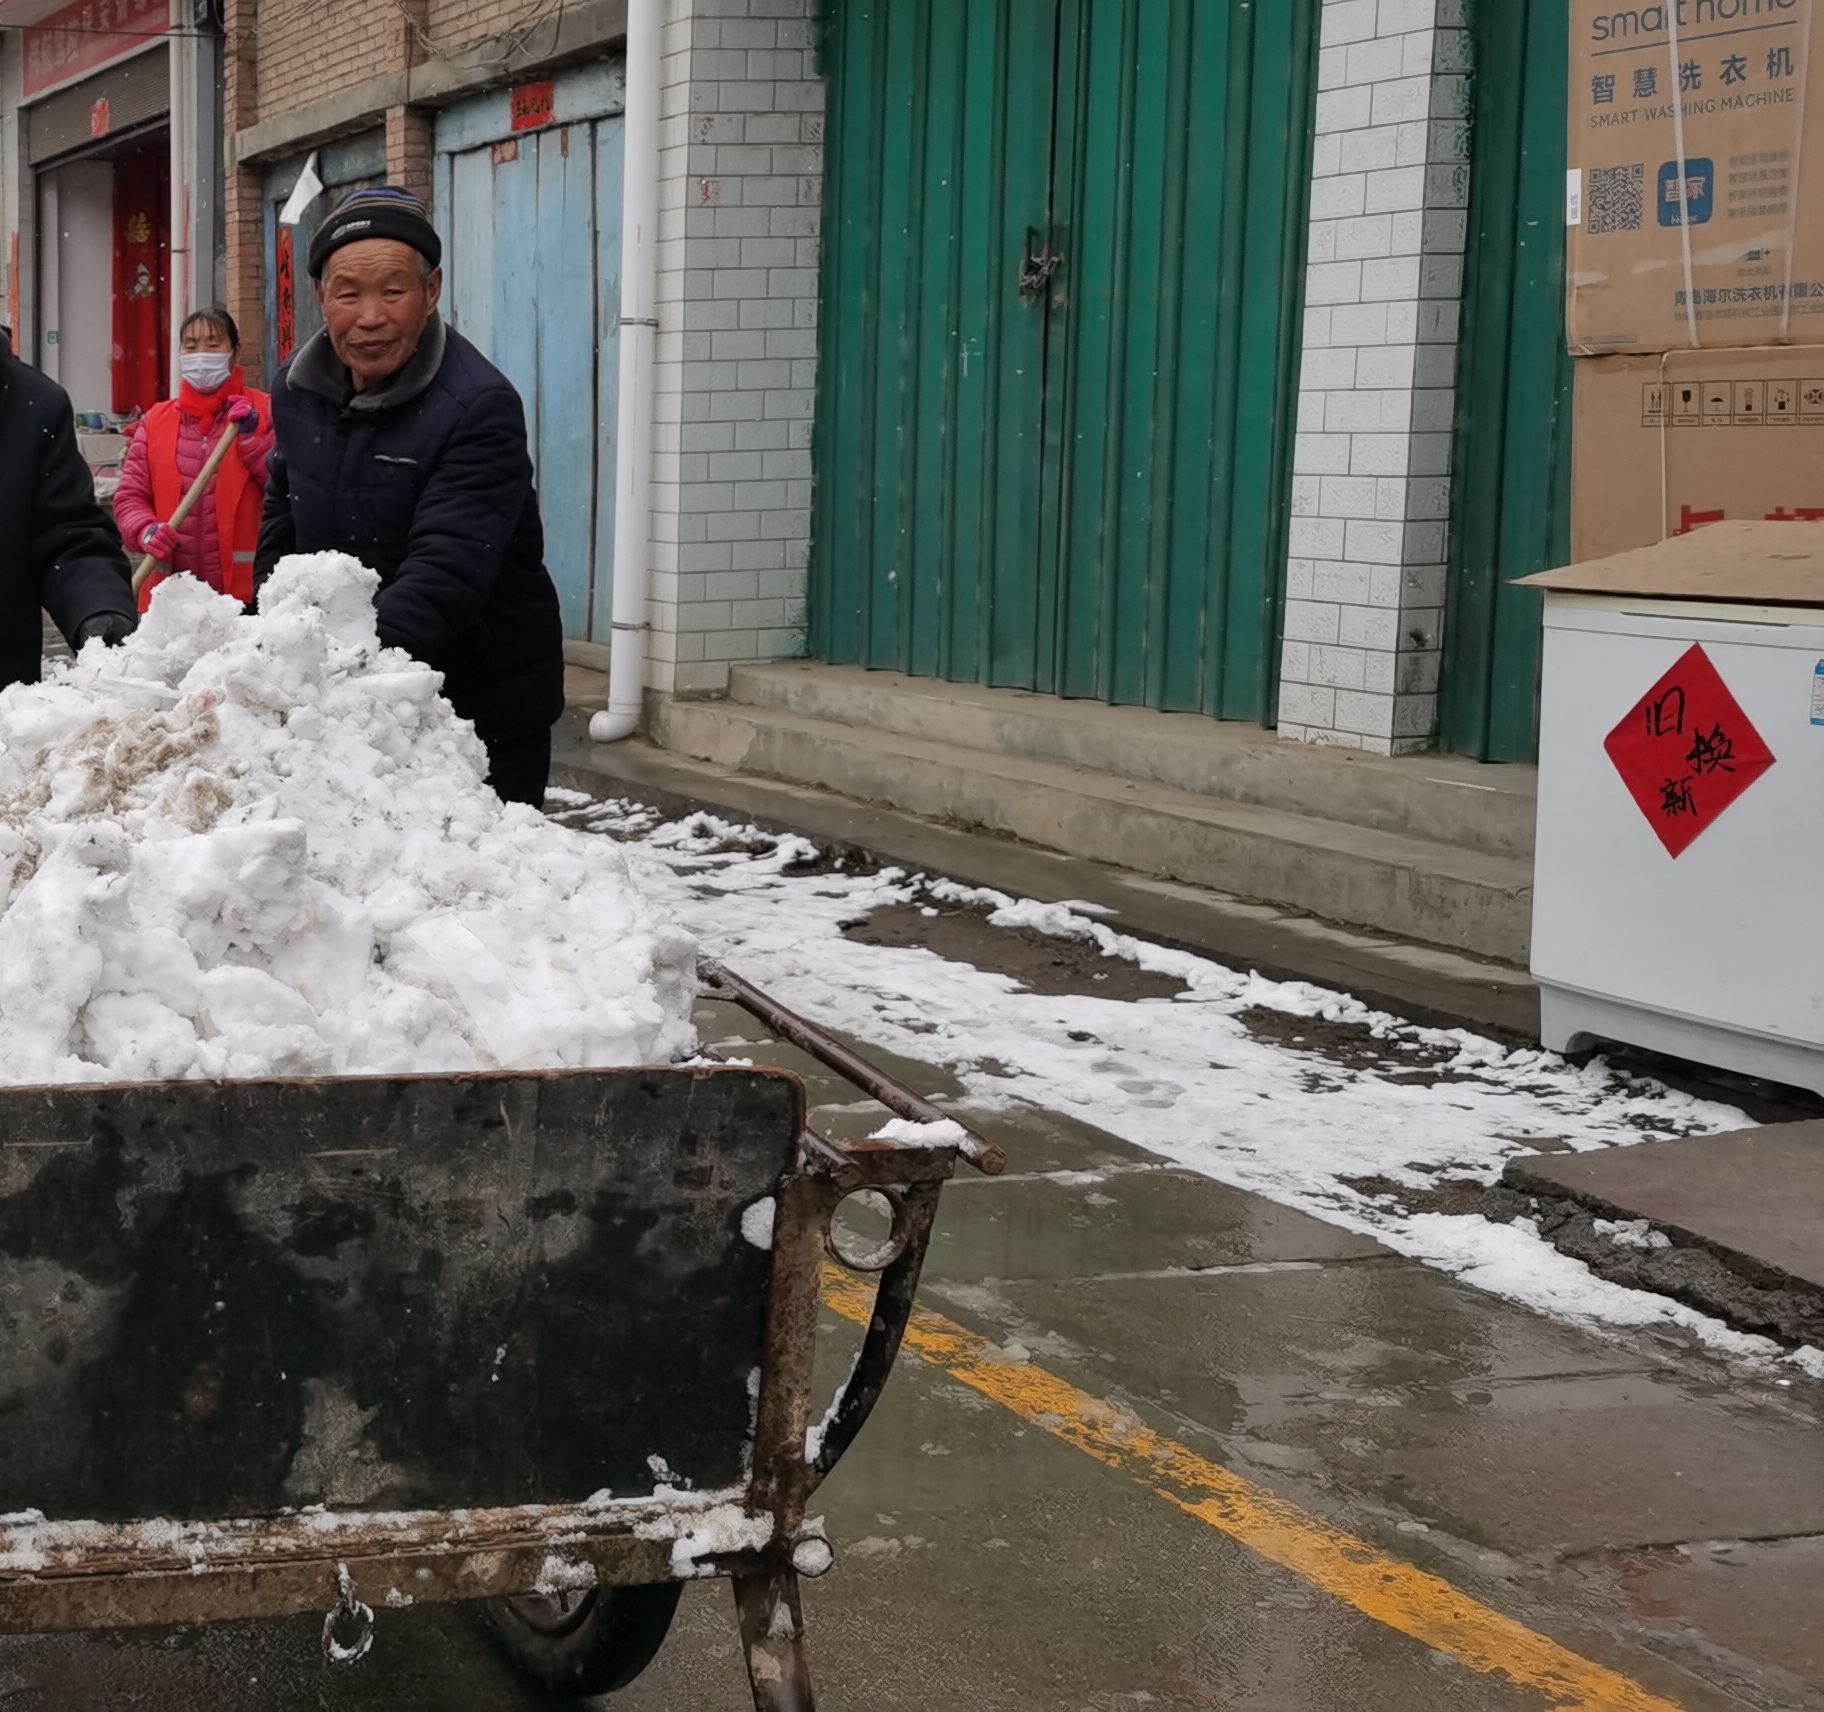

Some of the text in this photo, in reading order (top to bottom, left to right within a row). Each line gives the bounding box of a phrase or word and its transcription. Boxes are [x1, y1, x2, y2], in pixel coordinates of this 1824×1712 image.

[1591, 47, 1795, 106] 智慧洗衣机
[1590, 87, 1795, 129] SMART WASHING MACHINE
